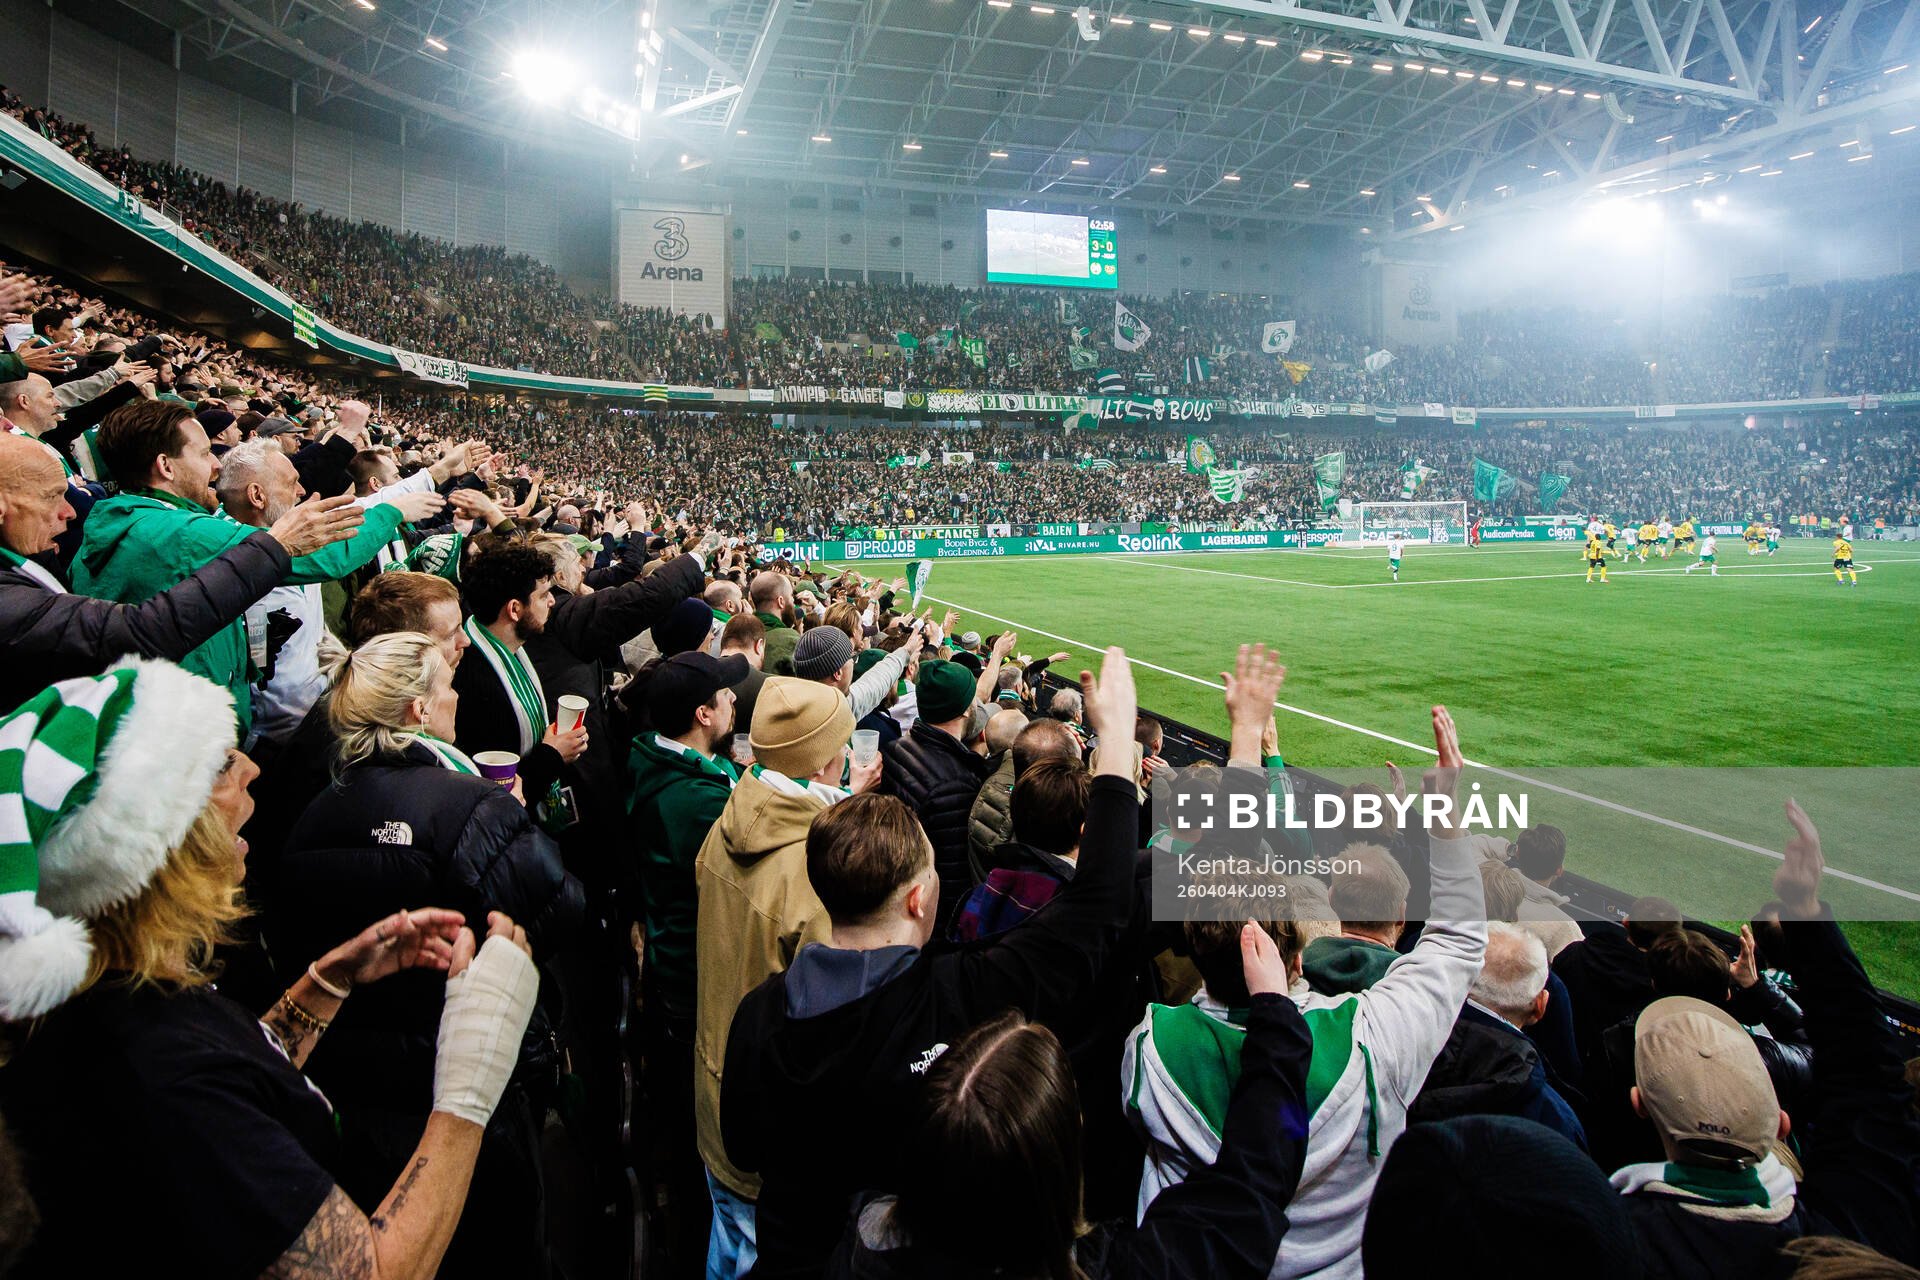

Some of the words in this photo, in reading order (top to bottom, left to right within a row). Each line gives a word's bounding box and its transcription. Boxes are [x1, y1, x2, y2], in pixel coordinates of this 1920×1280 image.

[1090, 220, 1115, 231] 62:58
[653, 217, 689, 261] 3
[640, 261, 703, 281] Arena
[1401, 303, 1441, 321] Arena
[780, 386, 826, 403] KOMPIS
[1023, 396, 1088, 411] ULTRAS
[1167, 399, 1214, 422] BOYS
[1042, 525, 1073, 536] BAJEN
[1482, 529, 1536, 539] AudicomPendax
[1547, 525, 1576, 538] clean
[1700, 525, 1711, 535] THE
[1732, 525, 1743, 535] BAR
[1117, 534, 1184, 551] Reolink
[1201, 534, 1269, 546] LAGERBAREN
[1291, 533, 1344, 544] INERSPORT
[863, 540, 916, 553] PROJOB
[1058, 541, 1100, 549] RIVARE.NU
[991, 547, 1005, 556] AB
[384, 821, 400, 830] THE
[371, 828, 400, 837] NORTH
[378, 836, 398, 845] FACE
[910, 1059, 931, 1073] NOR
[1696, 1121, 1730, 1135] POLO
